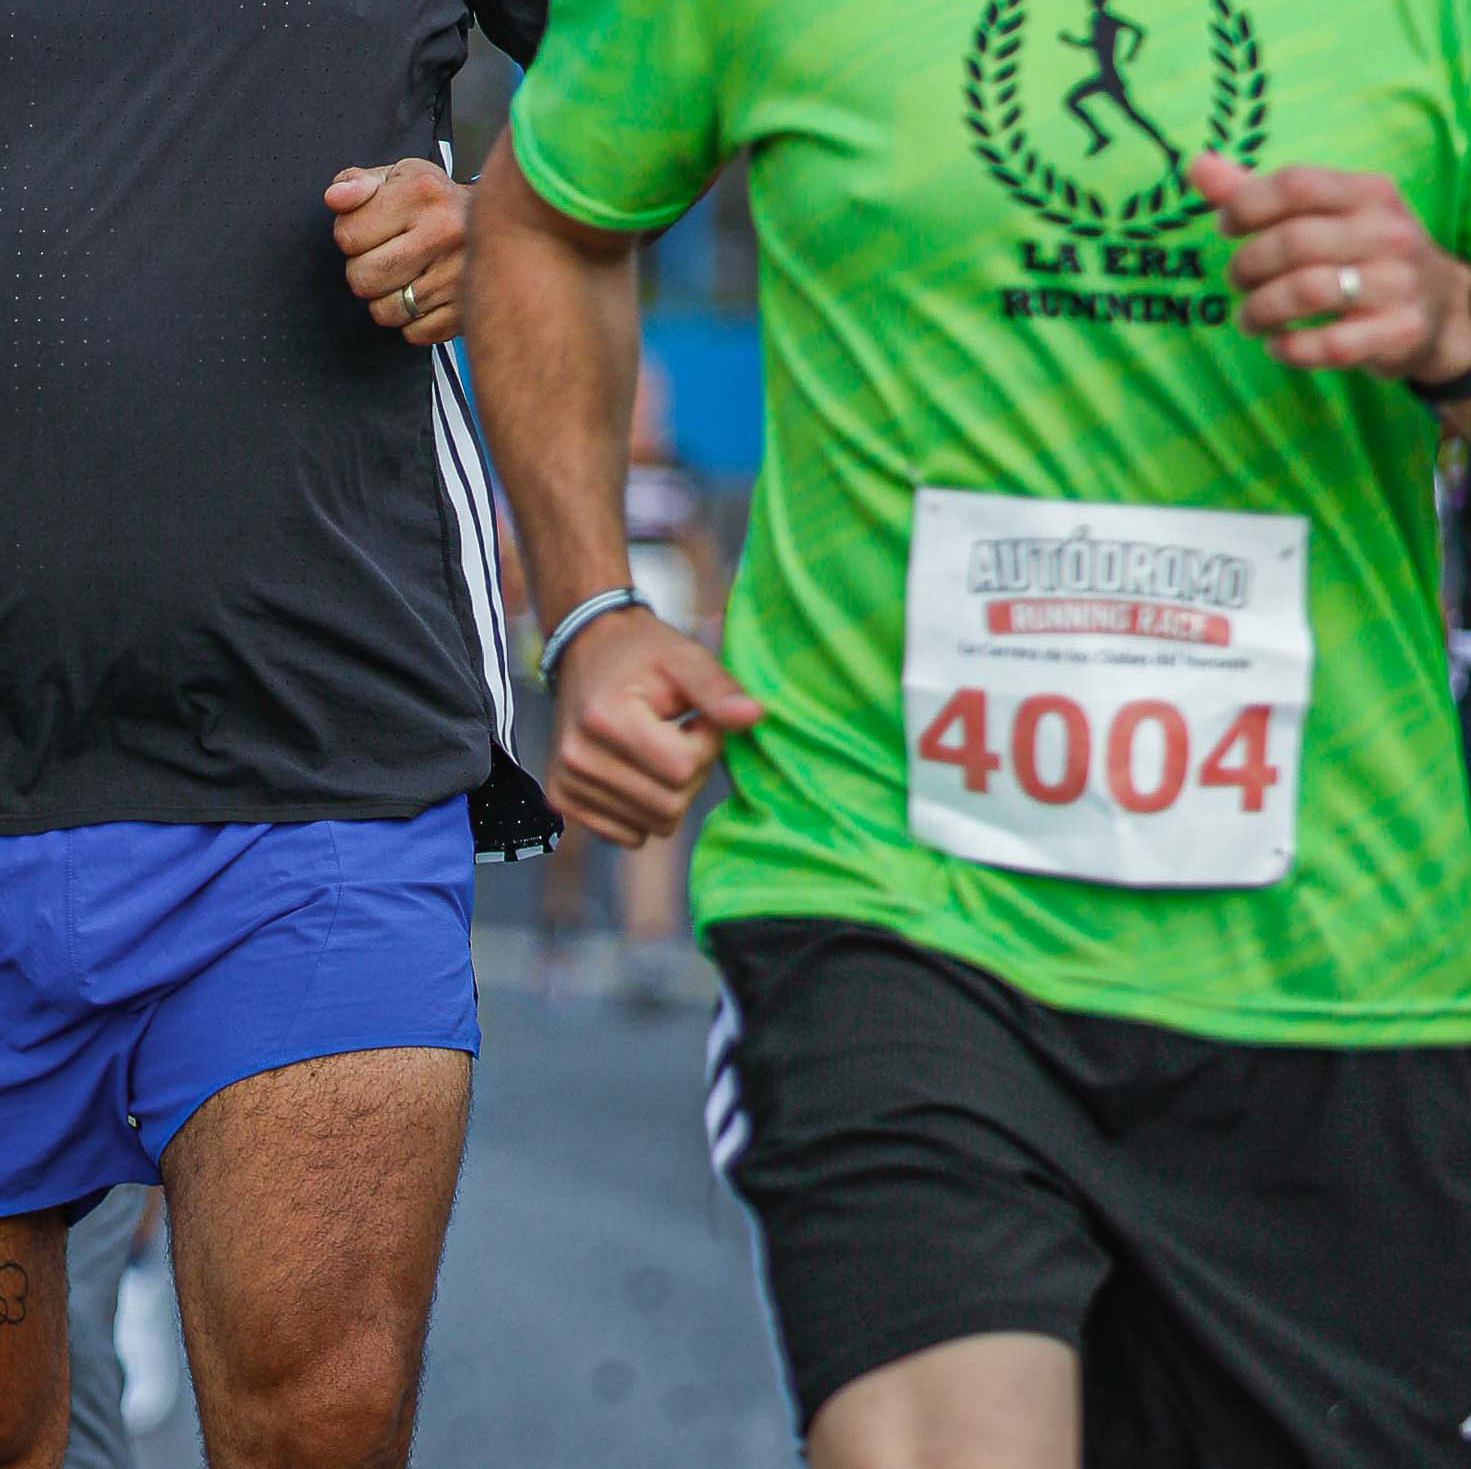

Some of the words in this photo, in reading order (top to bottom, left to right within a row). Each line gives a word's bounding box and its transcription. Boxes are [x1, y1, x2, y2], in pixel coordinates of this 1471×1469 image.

[1022, 241, 1081, 274] LA
[1103, 244, 1203, 279] ERA
[1001, 287, 1227, 326] RUNNING
[968, 524, 1252, 609] AUTÓDROMO
[917, 686, 1278, 814] 4004
